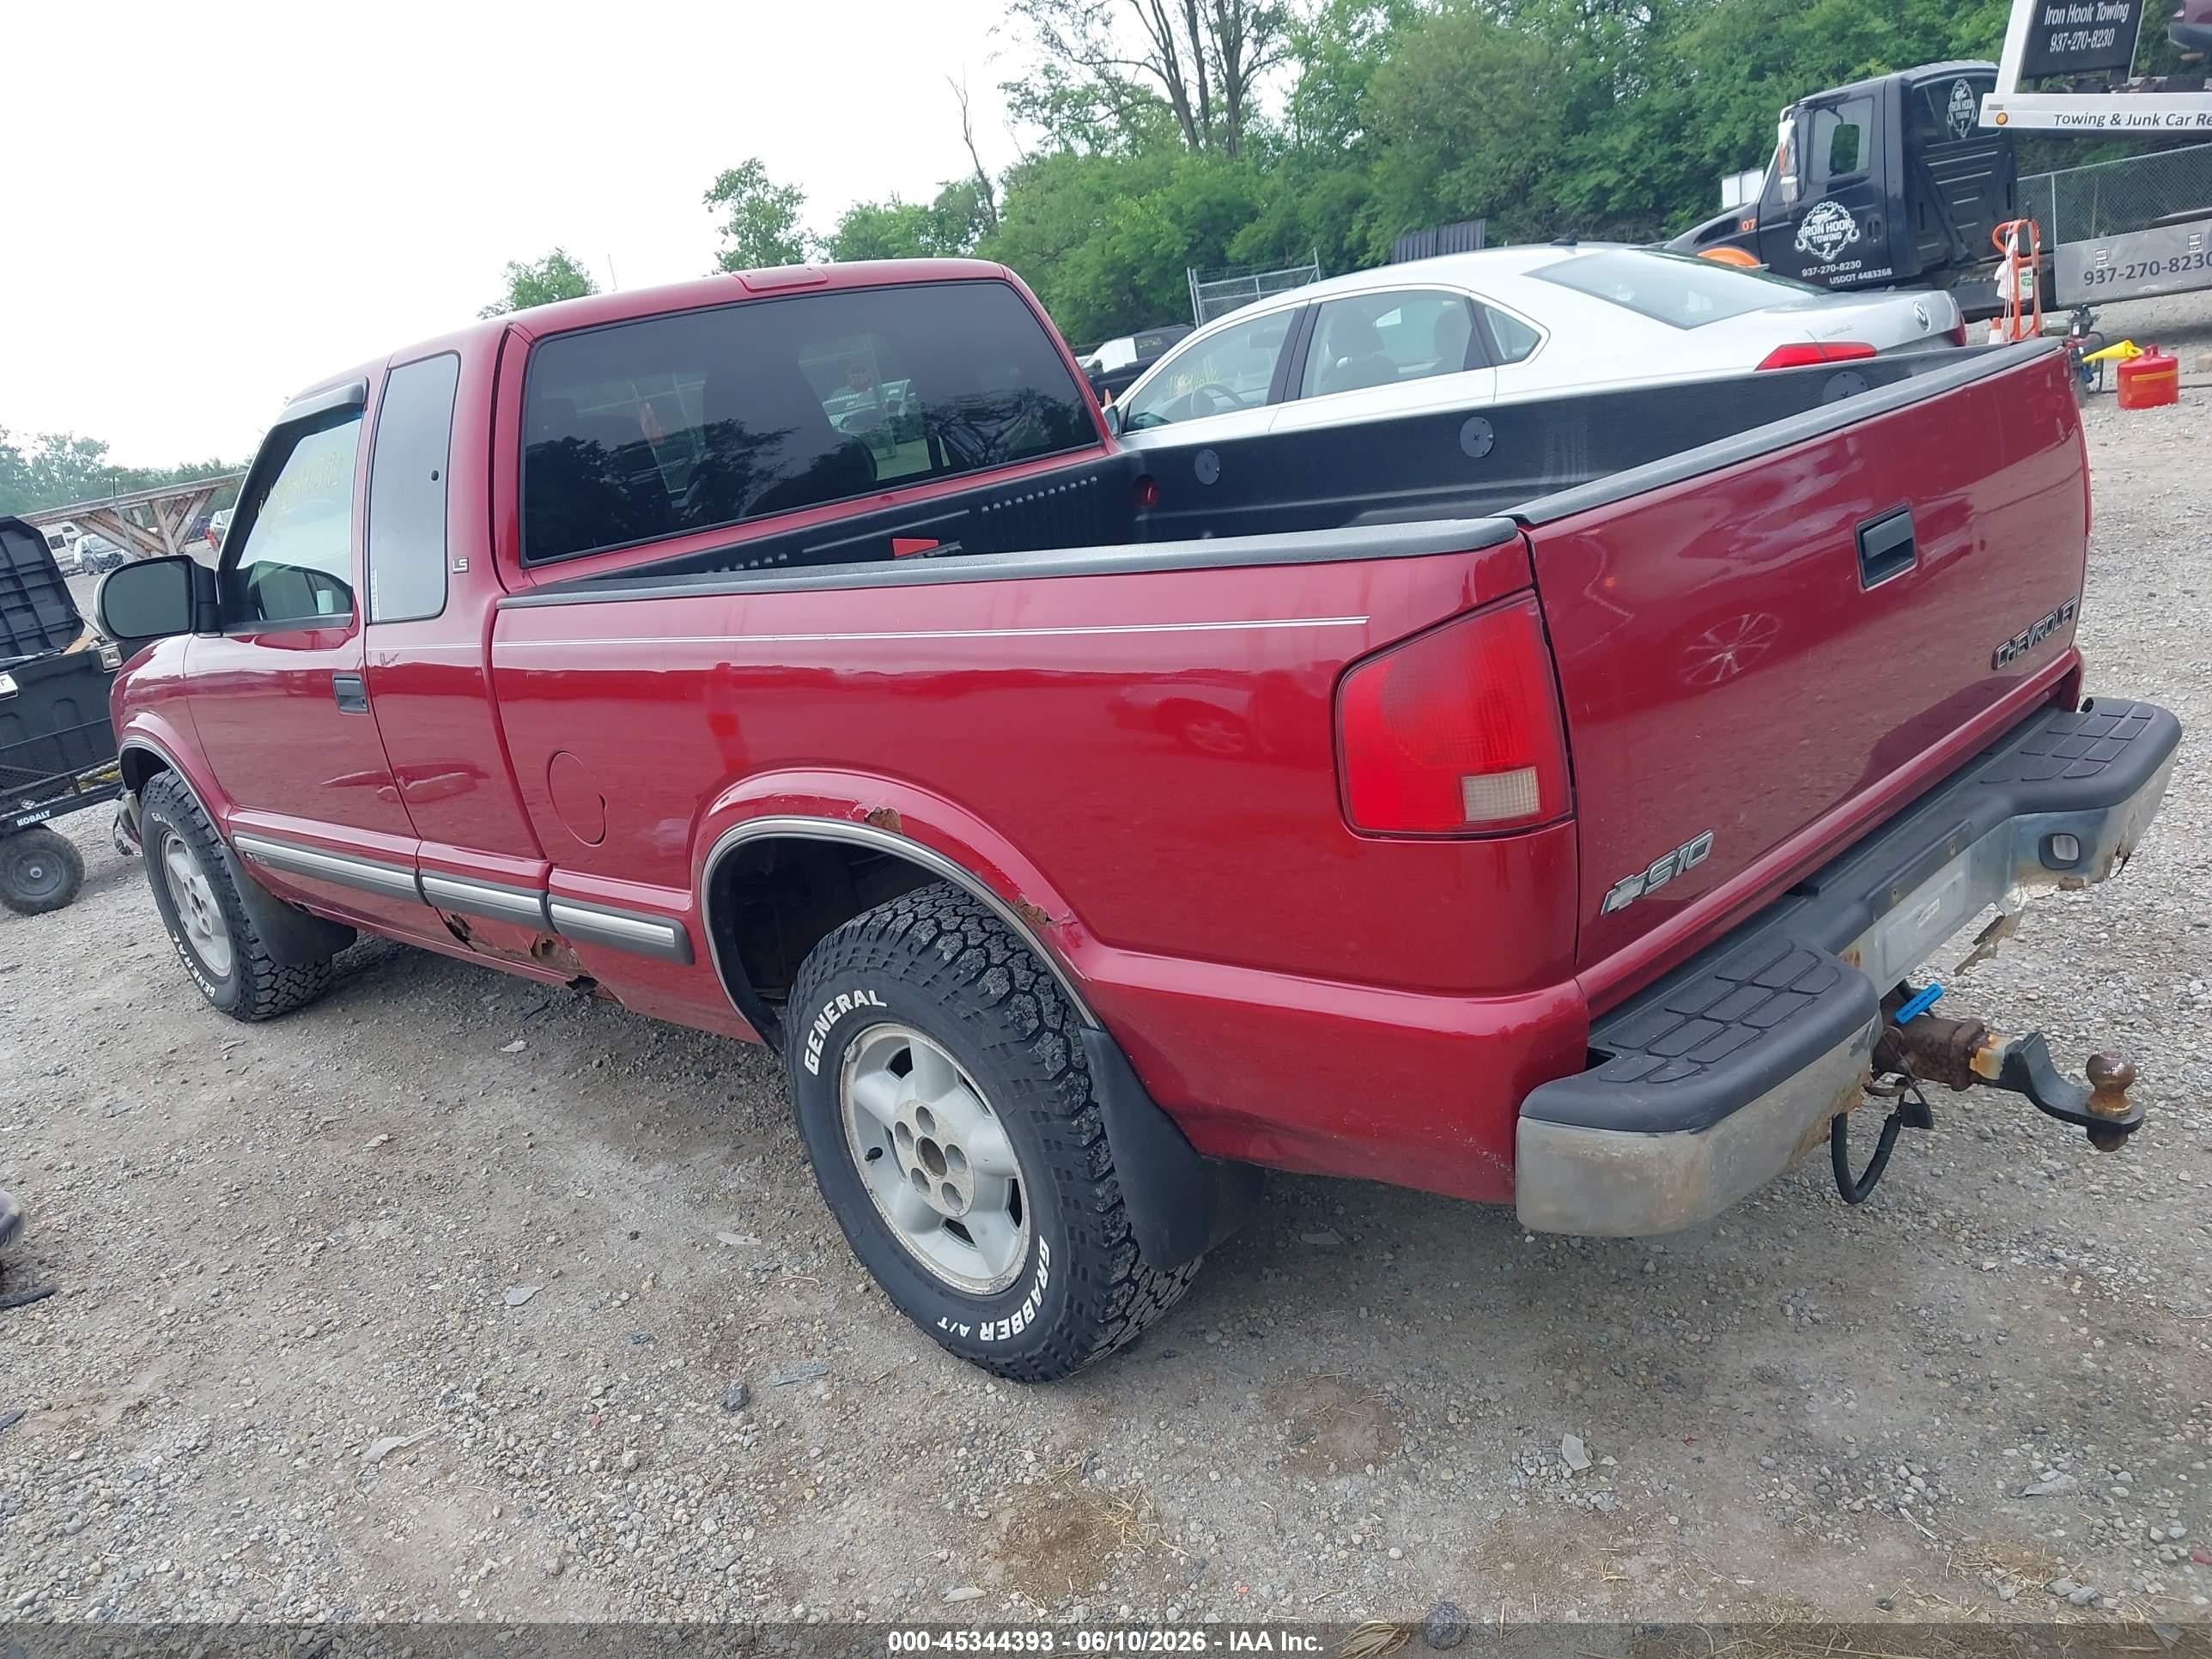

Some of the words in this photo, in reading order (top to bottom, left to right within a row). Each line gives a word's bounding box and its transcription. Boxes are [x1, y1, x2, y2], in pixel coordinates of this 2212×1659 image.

[2045, 5, 2065, 25] Iron
[2067, 3, 2094, 24] Hook
[2096, 1, 2130, 23] Towing
[2050, 28, 2115, 52] 937-270-8230
[2054, 112, 2106, 127] Towing
[2110, 112, 2121, 125] &
[2126, 112, 2160, 125] Junk
[2166, 113, 2192, 125] Car
[1741, 218, 1756, 231] 07
[1826, 219, 1852, 234] HOOK
[1812, 231, 1842, 244] TOWING
[1802, 259, 1862, 276] 937-270-8230
[1829, 273, 1856, 285] USDOT
[453, 557, 469, 573] LS
[1993, 596, 2079, 669] CHEVROLET
[16, 810, 51, 827] KOBALT
[1644, 830, 1714, 896] S10
[172, 929, 216, 998] GENERAL
[804, 989, 888, 1076] GENERAL
[979, 1235, 1050, 1341] GRABBER
[937, 1316, 971, 1338] A/T
